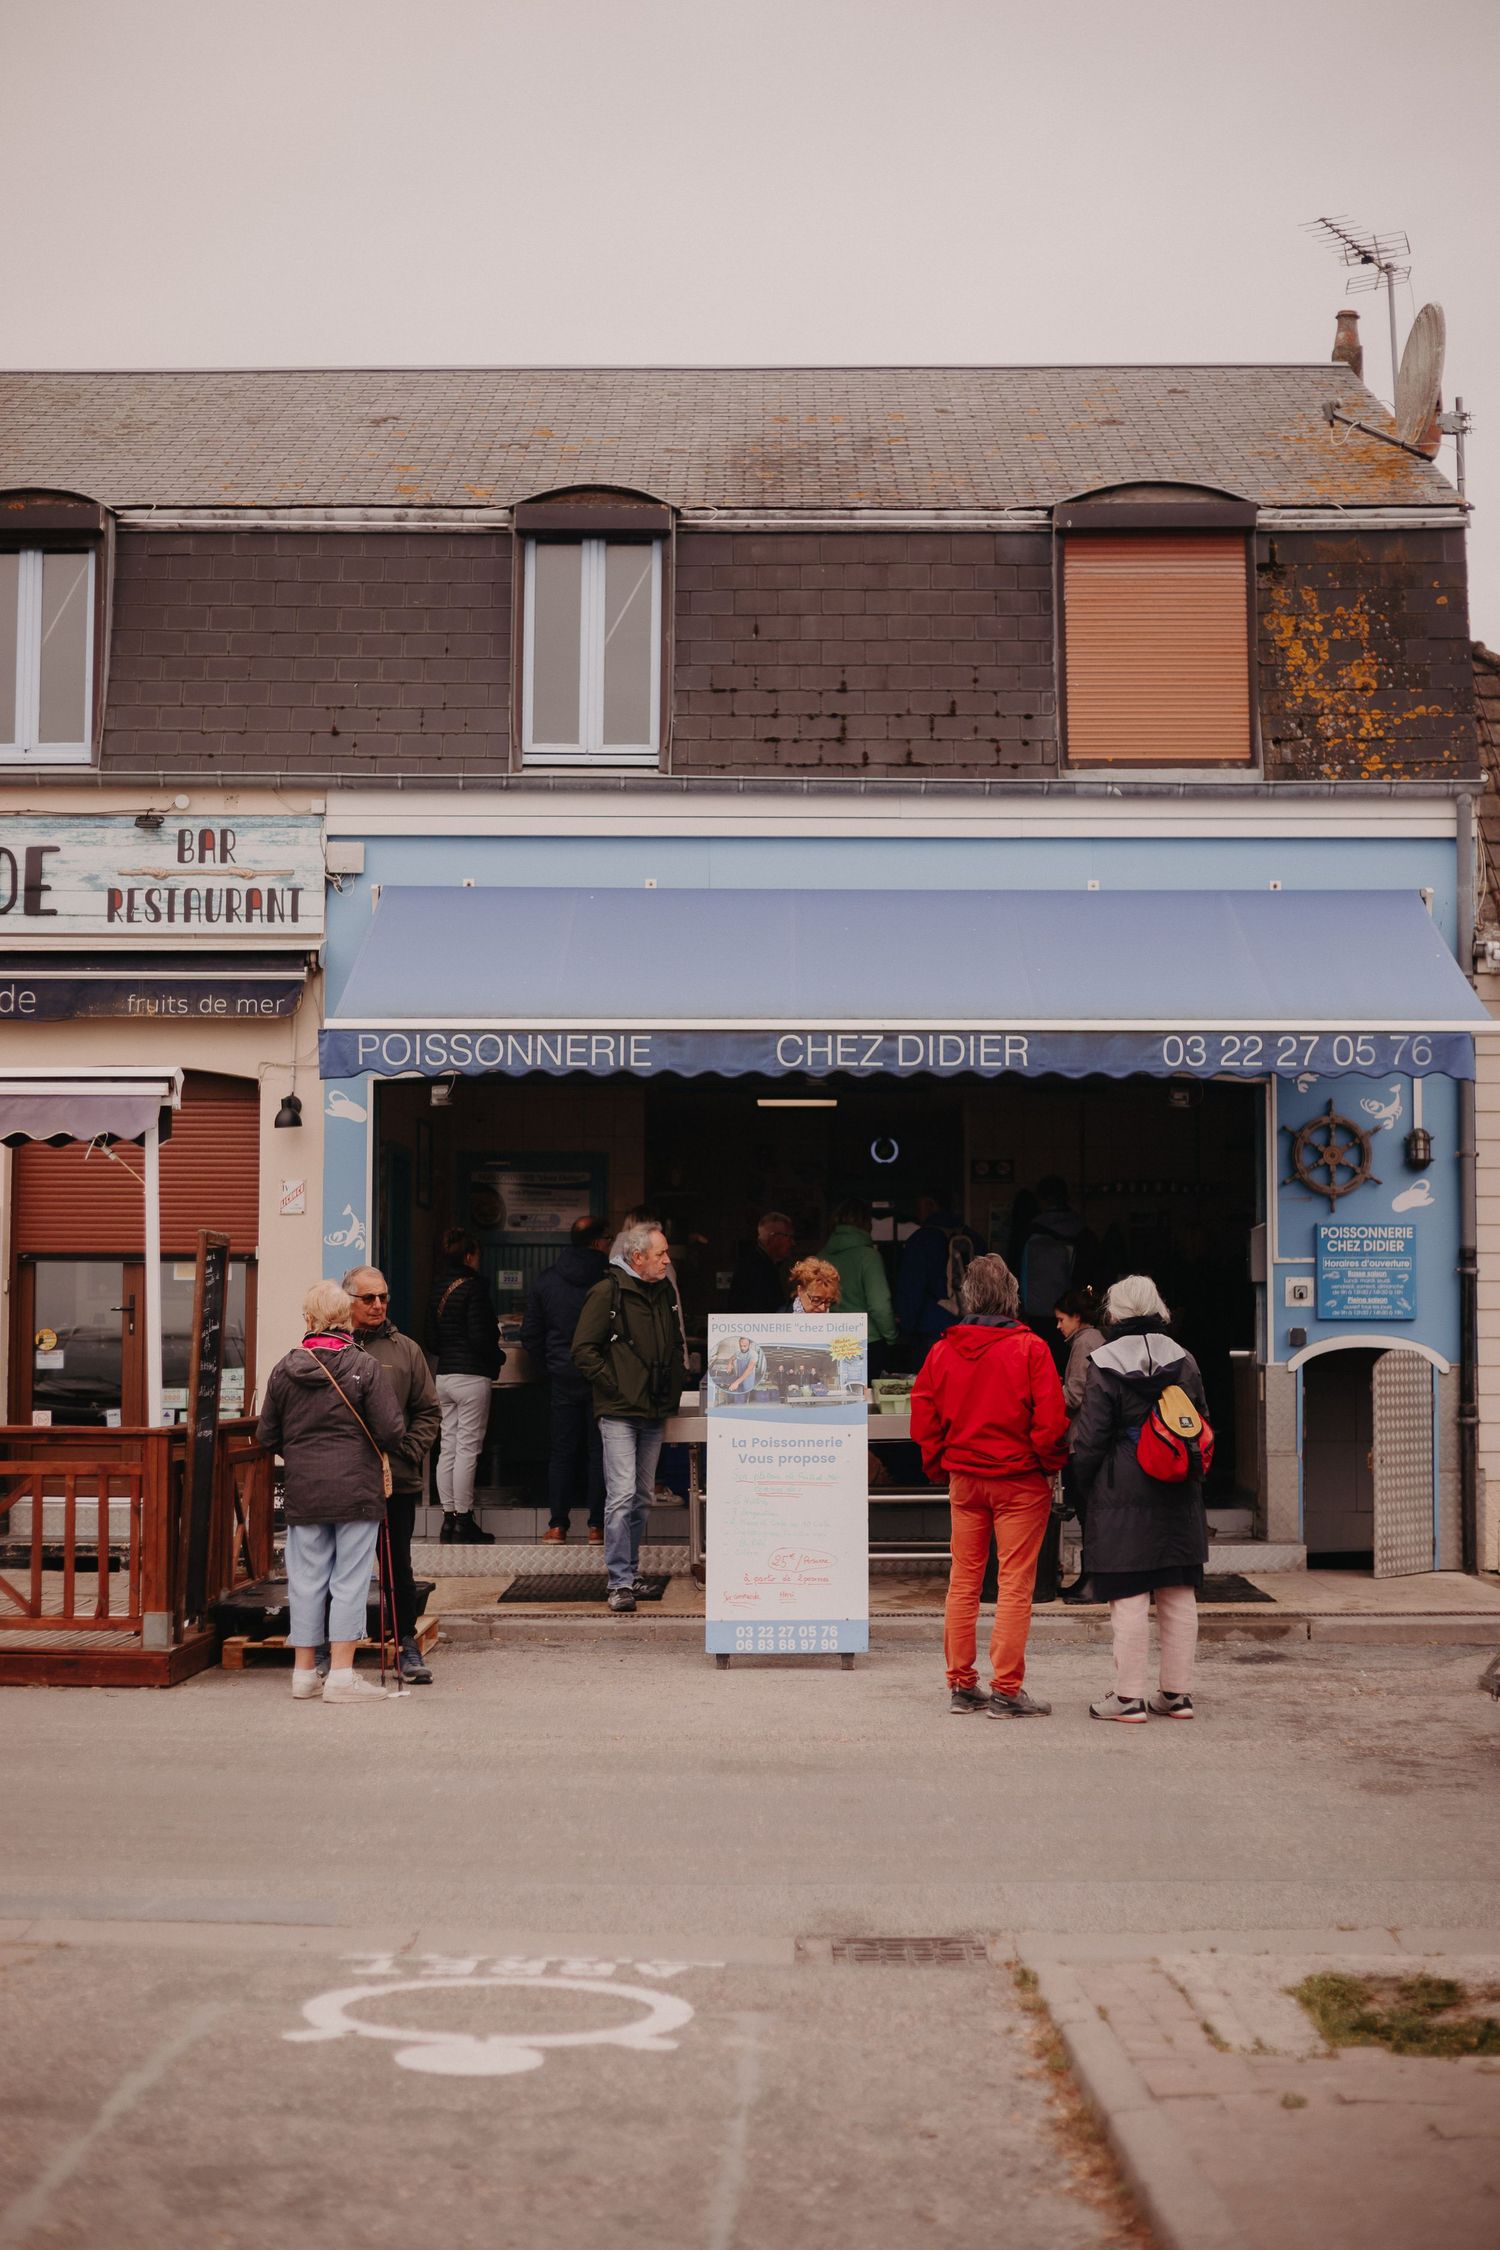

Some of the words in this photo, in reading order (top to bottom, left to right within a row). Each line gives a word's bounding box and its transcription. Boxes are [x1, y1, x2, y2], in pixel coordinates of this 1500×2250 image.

[177, 828, 236, 864] BAR
[107, 887, 304, 923] RESTAURANT
[128, 994, 188, 1014] fruits
[199, 994, 228, 1013] de
[237, 996, 285, 1013] mer
[358, 1033, 652, 1067] POISSONNERIE
[776, 1034, 884, 1067] CHEZ
[898, 1035, 1029, 1067] DIDIER
[1163, 1035, 1207, 1066] 03
[1220, 1035, 1263, 1066] 22
[1276, 1035, 1320, 1066] 27
[1333, 1035, 1376, 1066] 05
[1389, 1035, 1433, 1066] 76
[1320, 1226, 1414, 1239] POISSONNERIE
[1327, 1240, 1361, 1252] CHEZ
[1363, 1240, 1405, 1252] DIDIER
[1324, 1259, 1359, 1267] Horaires
[1361, 1259, 1410, 1267] d'ouverture
[711, 1322, 792, 1333] POISSONNERIE
[732, 1437, 747, 1448] La
[752, 1436, 843, 1448] Poissonnerie
[738, 1453, 773, 1464] Vous
[778, 1454, 836, 1466] propose
[736, 1626, 753, 1638] 03
[758, 1626, 774, 1638] 22
[778, 1626, 795, 1638] 27
[799, 1626, 816, 1638] 05
[821, 1626, 838, 1638] 76
[736, 1639, 753, 1651] 06
[758, 1639, 774, 1651] 83
[779, 1639, 796, 1651] 68
[800, 1639, 816, 1651] 97
[821, 1639, 838, 1651] 90
